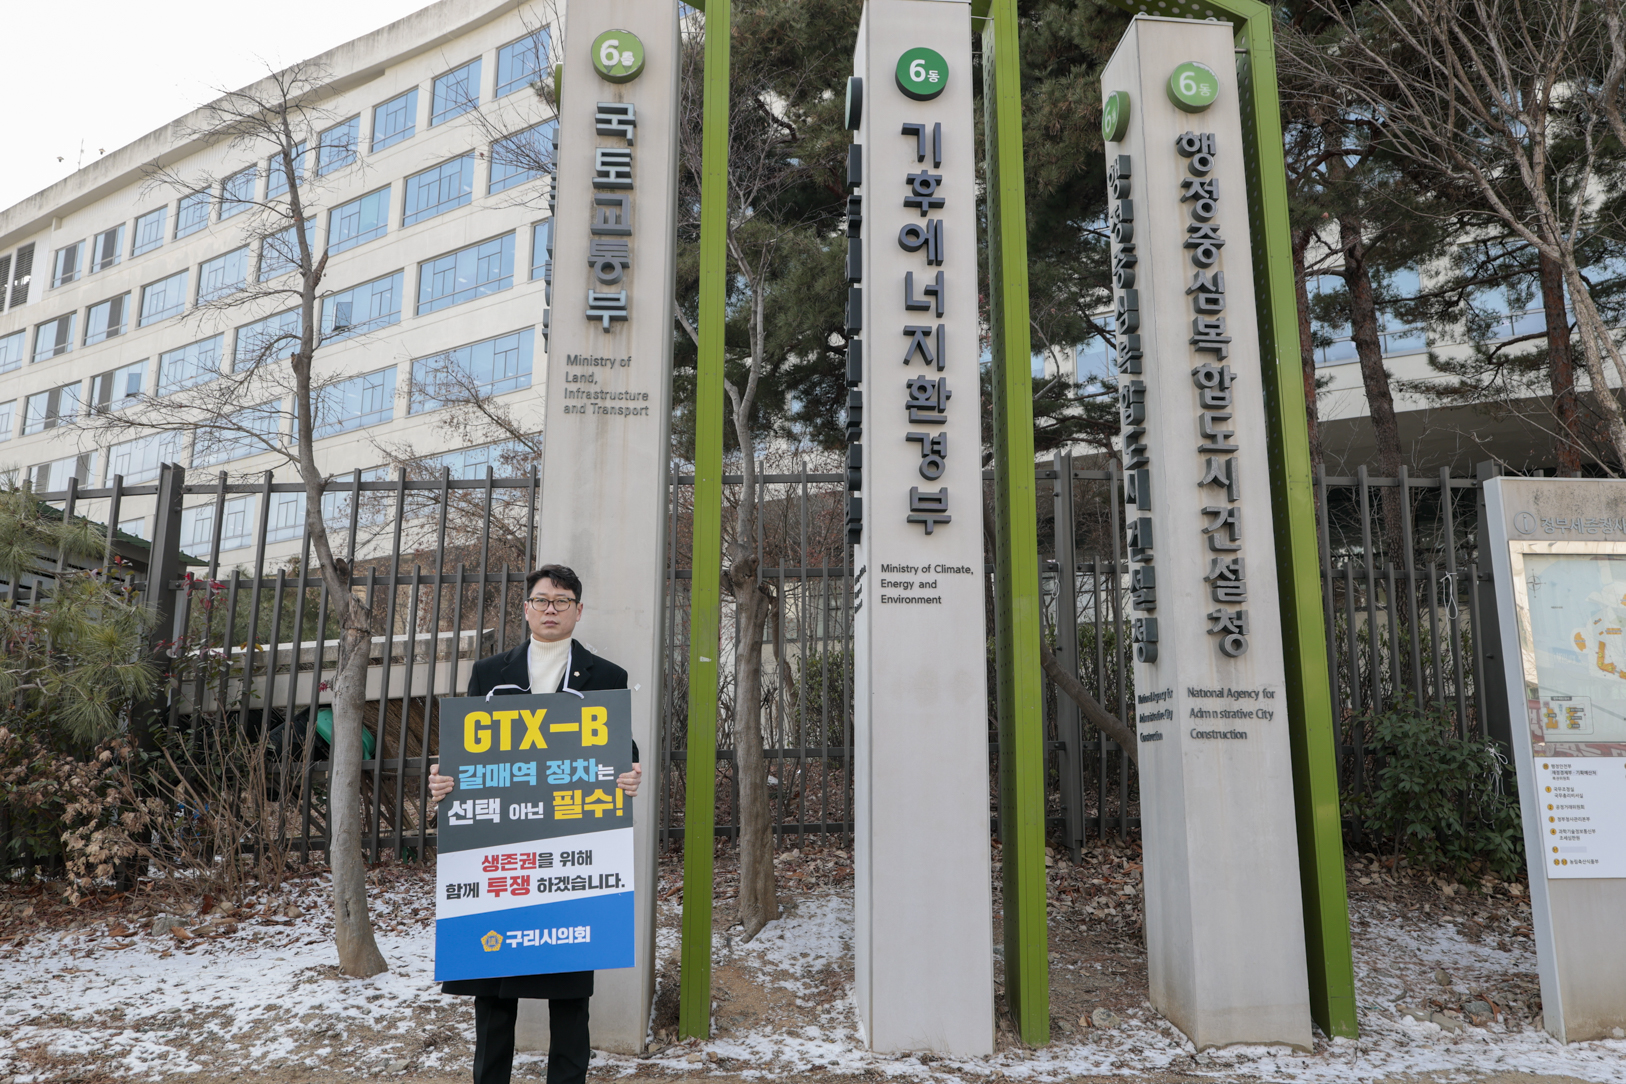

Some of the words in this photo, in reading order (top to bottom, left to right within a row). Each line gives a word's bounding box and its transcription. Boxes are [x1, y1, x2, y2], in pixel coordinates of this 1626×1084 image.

[909, 59, 940, 83] 6동
[1179, 71, 1212, 97] 6동
[585, 101, 637, 333] 국토교통부
[898, 122, 952, 535] 기후에너지환경부
[566, 354, 616, 369] Ministry
[620, 356, 632, 367] of
[565, 371, 598, 385] Land,
[564, 387, 649, 401] Infrastructure
[1176, 131, 1250, 658] 행정중심복합도시건설청
[563, 403, 586, 414] and
[590, 402, 649, 418] Transport
[881, 563, 919, 575] Ministry
[921, 564, 932, 574] of
[934, 564, 974, 575] Climate,
[880, 578, 915, 591] Energy
[918, 579, 938, 589] and
[880, 594, 942, 605] Environment
[1187, 686, 1225, 699] National
[1226, 687, 1260, 701] Agency
[1262, 688, 1275, 699] for
[1255, 708, 1274, 721] City
[463, 706, 608, 753] GTX-B
[1190, 728, 1248, 740] Construction
[458, 761, 537, 790] 갈매역
[545, 758, 614, 785] 정차는
[448, 798, 500, 826] 선택
[509, 802, 544, 820] 아닌
[553, 788, 623, 820] 필수!
[482, 851, 554, 873] 생존권을
[559, 850, 593, 867] 위해
[446, 882, 480, 900] 함께
[487, 875, 531, 898] 투쟁
[537, 873, 626, 893] 하겠습니다.
[505, 926, 591, 948] 구리시의회
